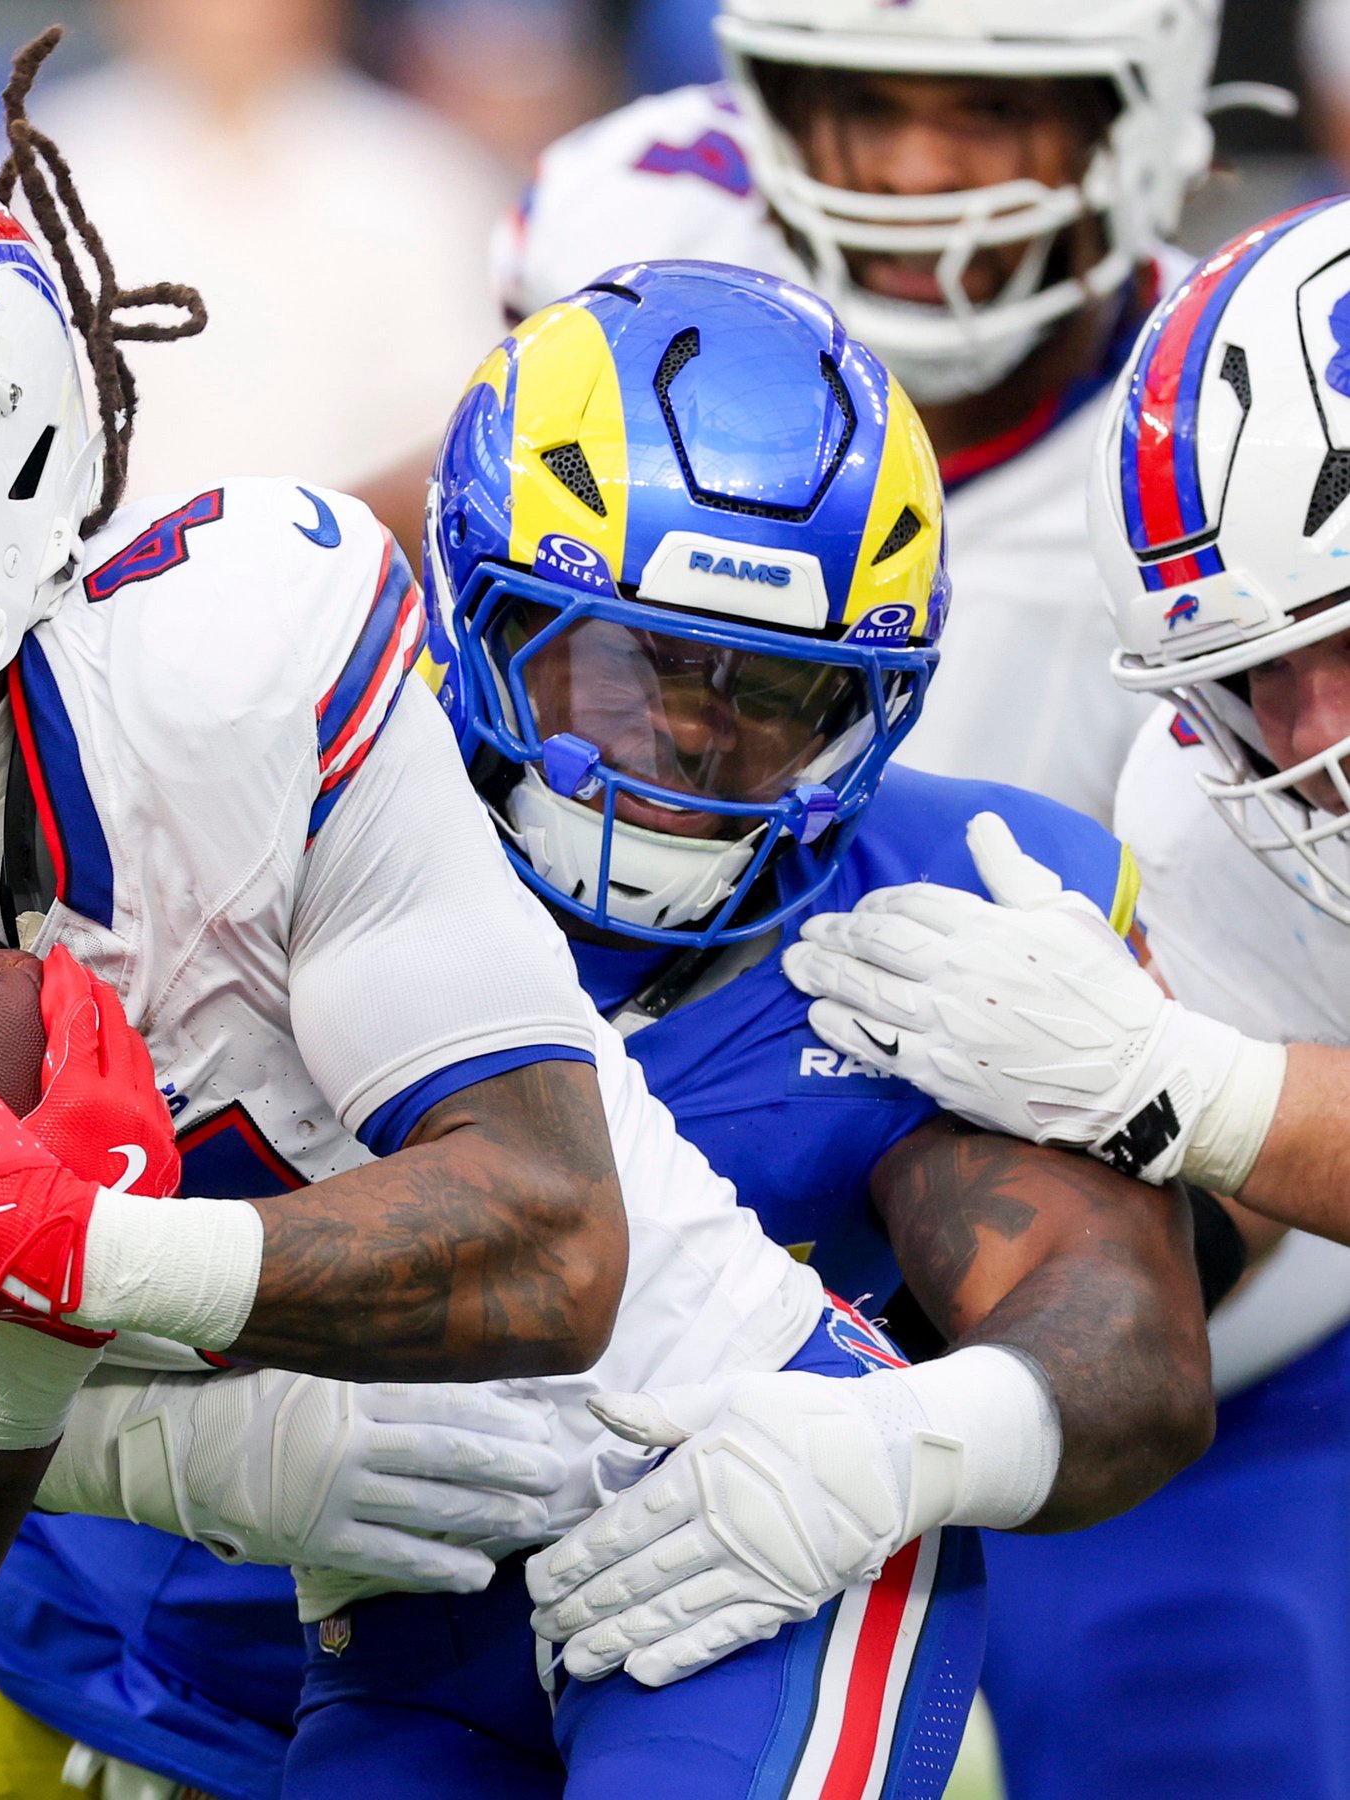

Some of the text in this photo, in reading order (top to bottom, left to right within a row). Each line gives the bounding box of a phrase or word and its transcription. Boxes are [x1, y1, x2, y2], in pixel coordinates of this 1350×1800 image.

[83, 487, 224, 603] 4
[537, 548, 606, 587] OAKLEY
[689, 550, 792, 587] RAMS
[855, 625, 912, 639] OAKLEY
[799, 1047, 892, 1078] RA
